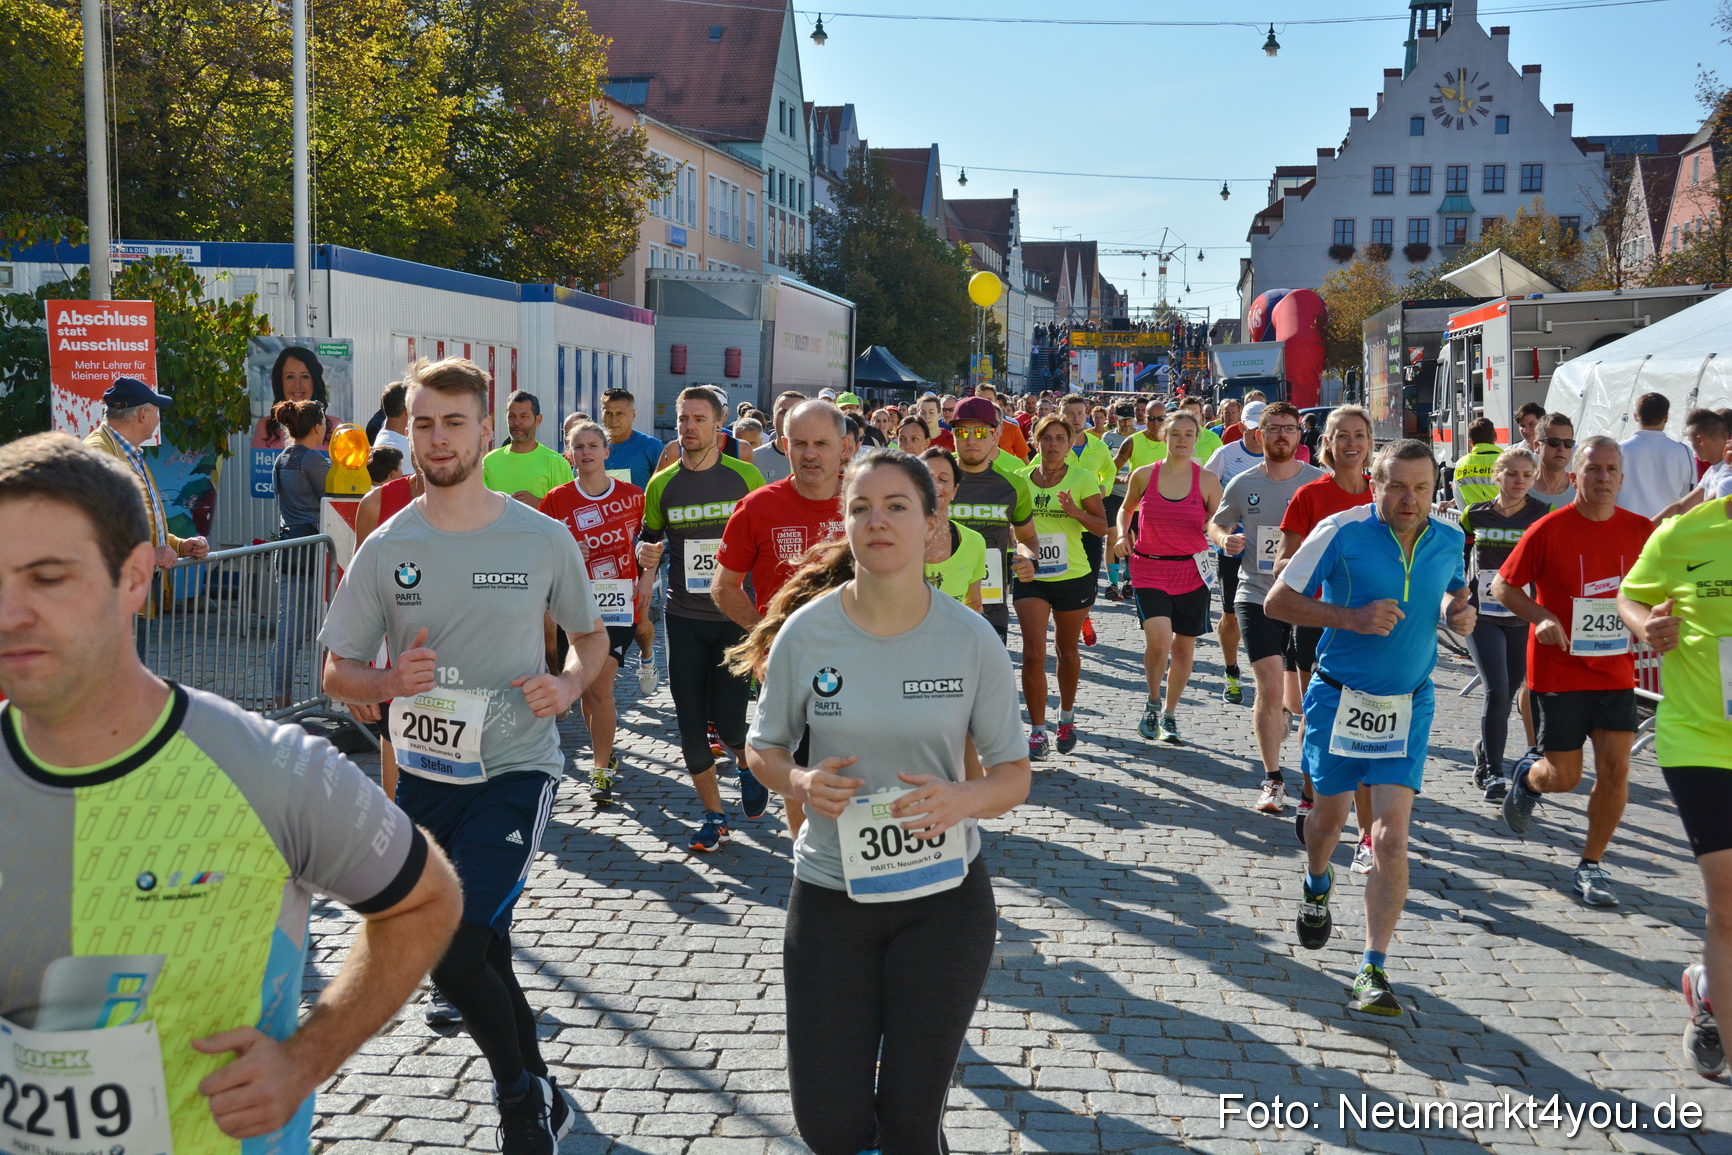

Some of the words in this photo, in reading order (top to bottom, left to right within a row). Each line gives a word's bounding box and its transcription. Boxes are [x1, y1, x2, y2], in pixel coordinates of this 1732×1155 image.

[57, 310, 148, 326] Abschluss
[57, 327, 87, 336] statt
[59, 338, 149, 351] Ausschluss!
[1103, 335, 1137, 345] START
[75, 361, 100, 369] Mehr
[102, 361, 132, 370] Lehrer
[134, 360, 146, 369] für
[71, 371, 109, 380] kleinere
[255, 452, 275, 466] Hel
[667, 501, 740, 523] BOCK
[779, 544, 802, 552] NEU
[473, 573, 528, 585] BOCK
[594, 592, 626, 607] 225
[437, 666, 464, 685] 19.
[903, 678, 963, 694] BOCK
[415, 695, 456, 711] BOCK
[815, 701, 842, 710] PARTL
[1362, 698, 1392, 709] BOCK
[1346, 708, 1396, 733] 2601
[402, 711, 466, 748] 2057
[410, 743, 428, 752] PARTL
[428, 747, 453, 757] Neumarkt
[1351, 742, 1387, 752] Michael
[421, 757, 453, 774] Stefan
[871, 862, 897, 872] PARTL
[897, 856, 932, 868] Neumarkt
[0, 1073, 132, 1139] 2219
